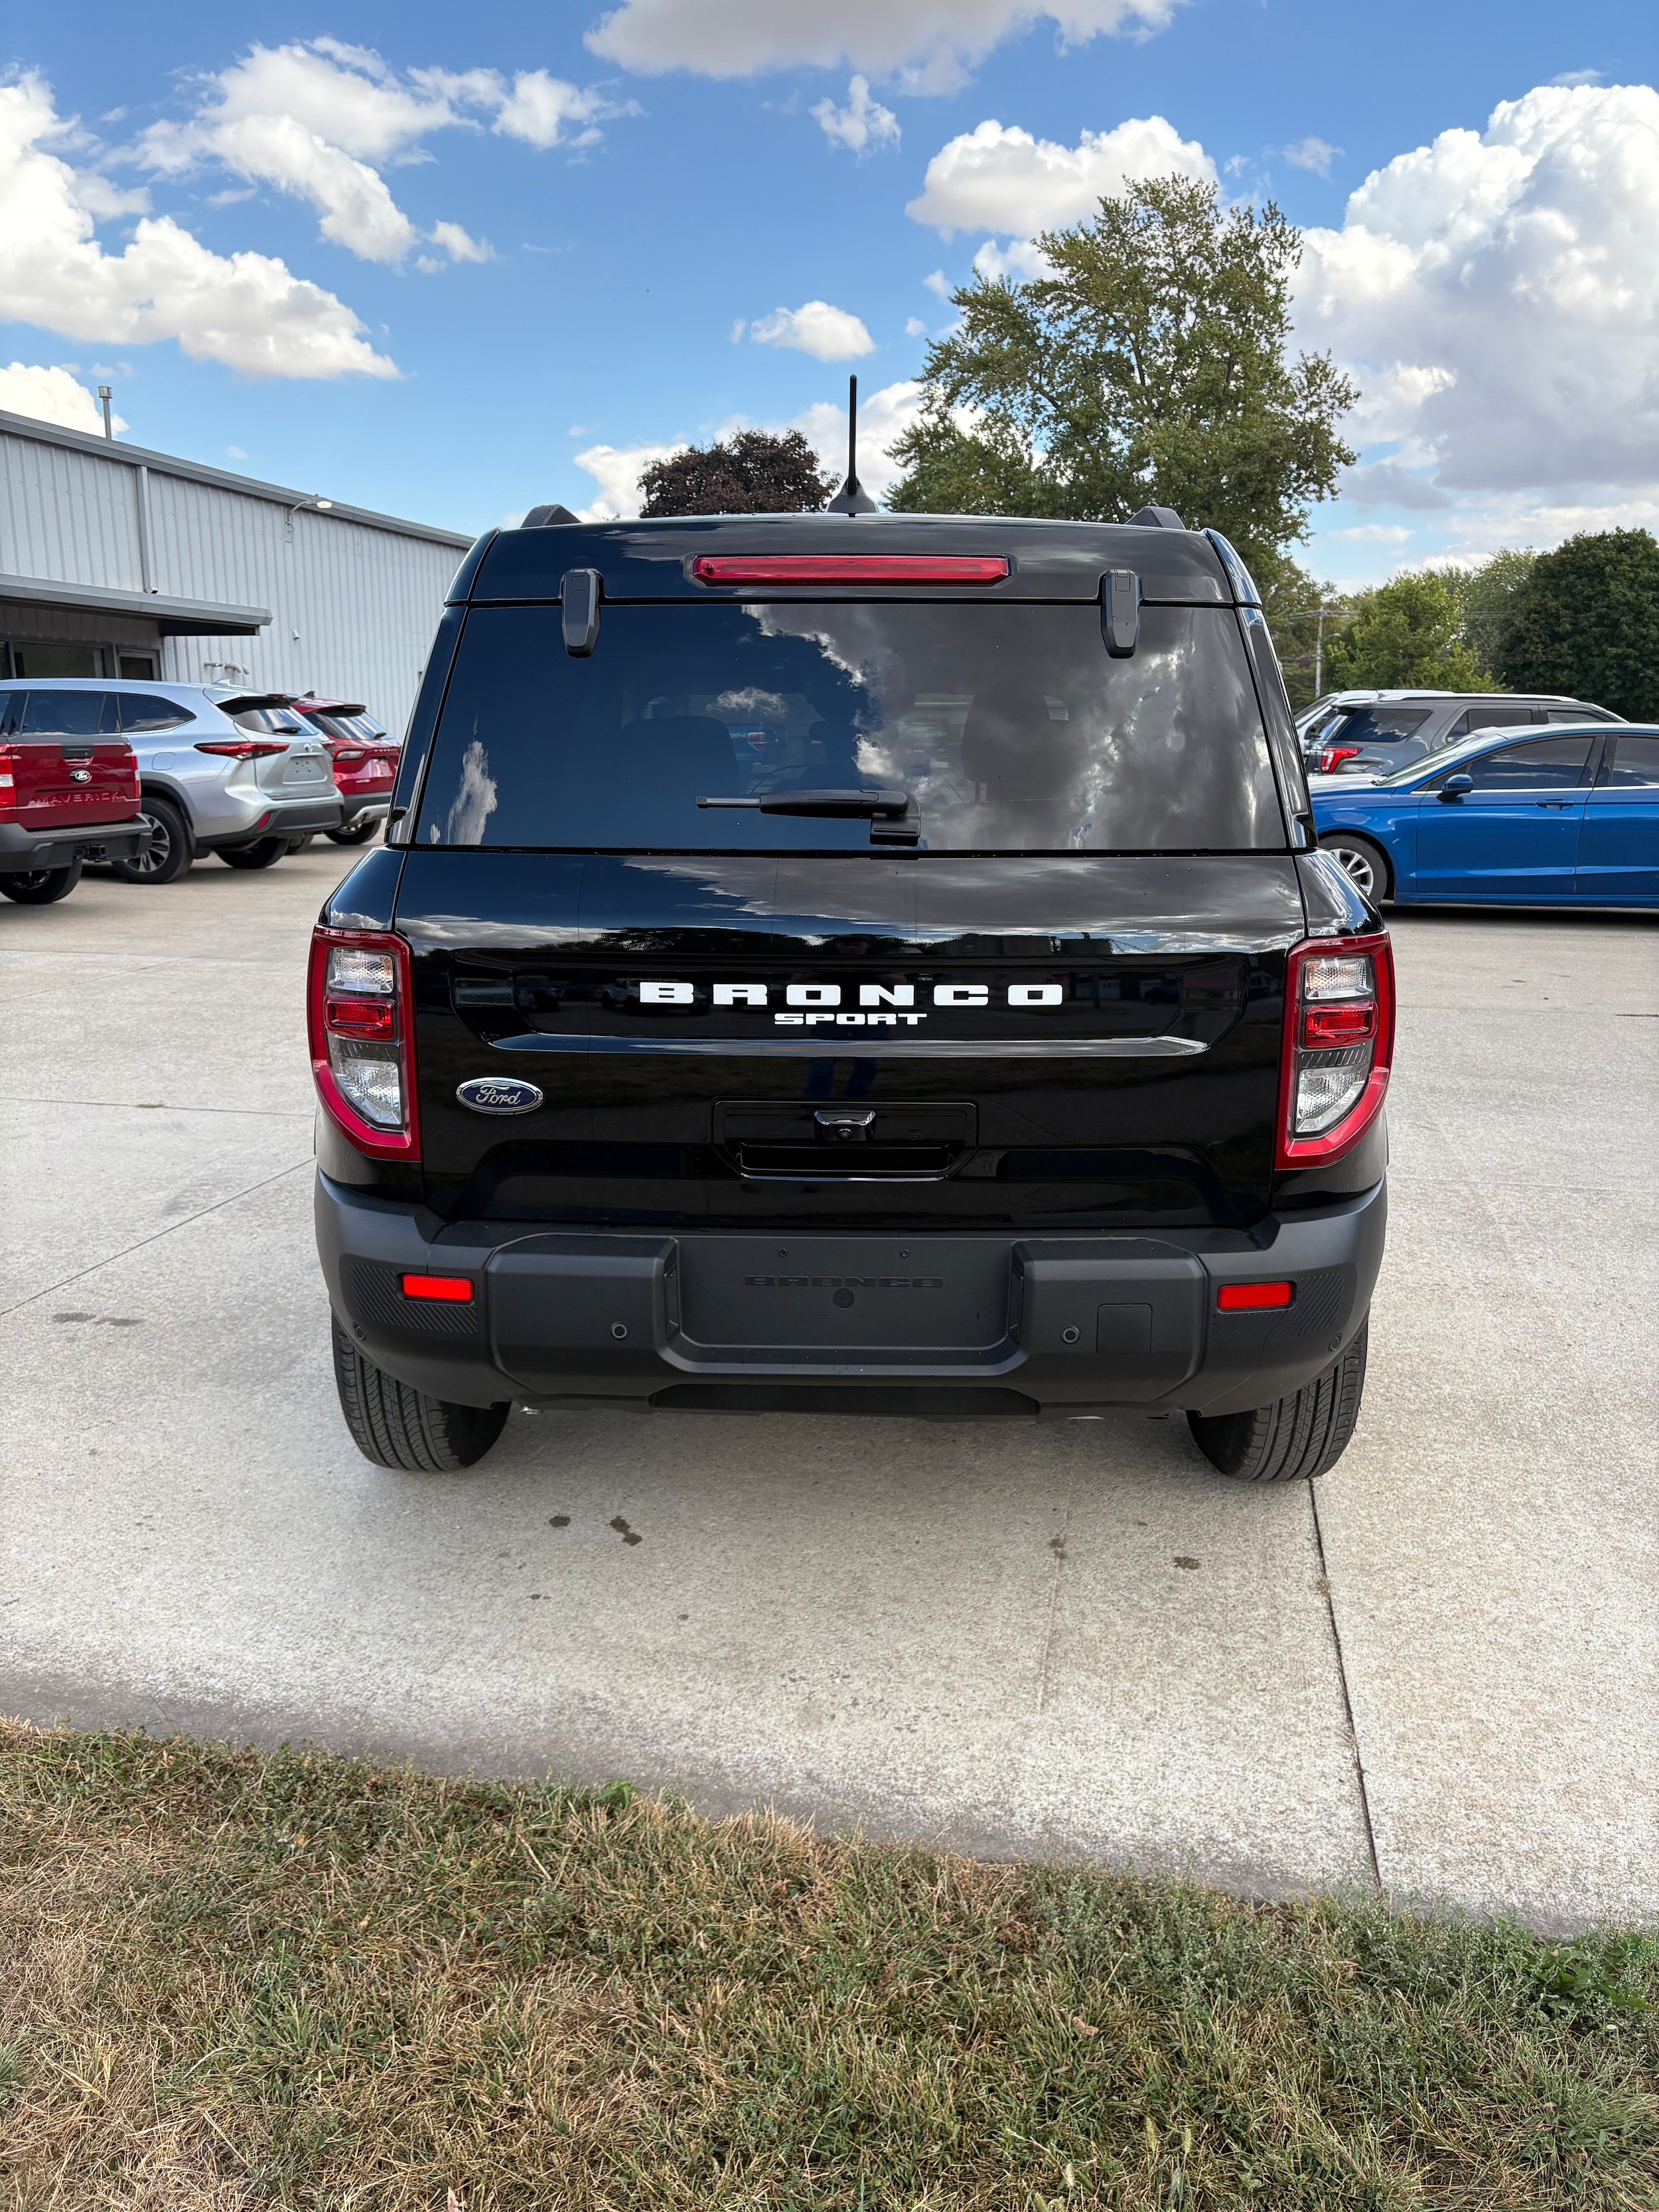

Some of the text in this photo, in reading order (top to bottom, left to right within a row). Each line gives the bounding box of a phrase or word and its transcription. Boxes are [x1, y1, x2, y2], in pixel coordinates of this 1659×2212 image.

[639, 982, 1063, 1007] BRONCO
[774, 1013, 927, 1025] SPORT
[476, 1084, 522, 1104] Ford
[745, 1275, 944, 1288] BRONCO
